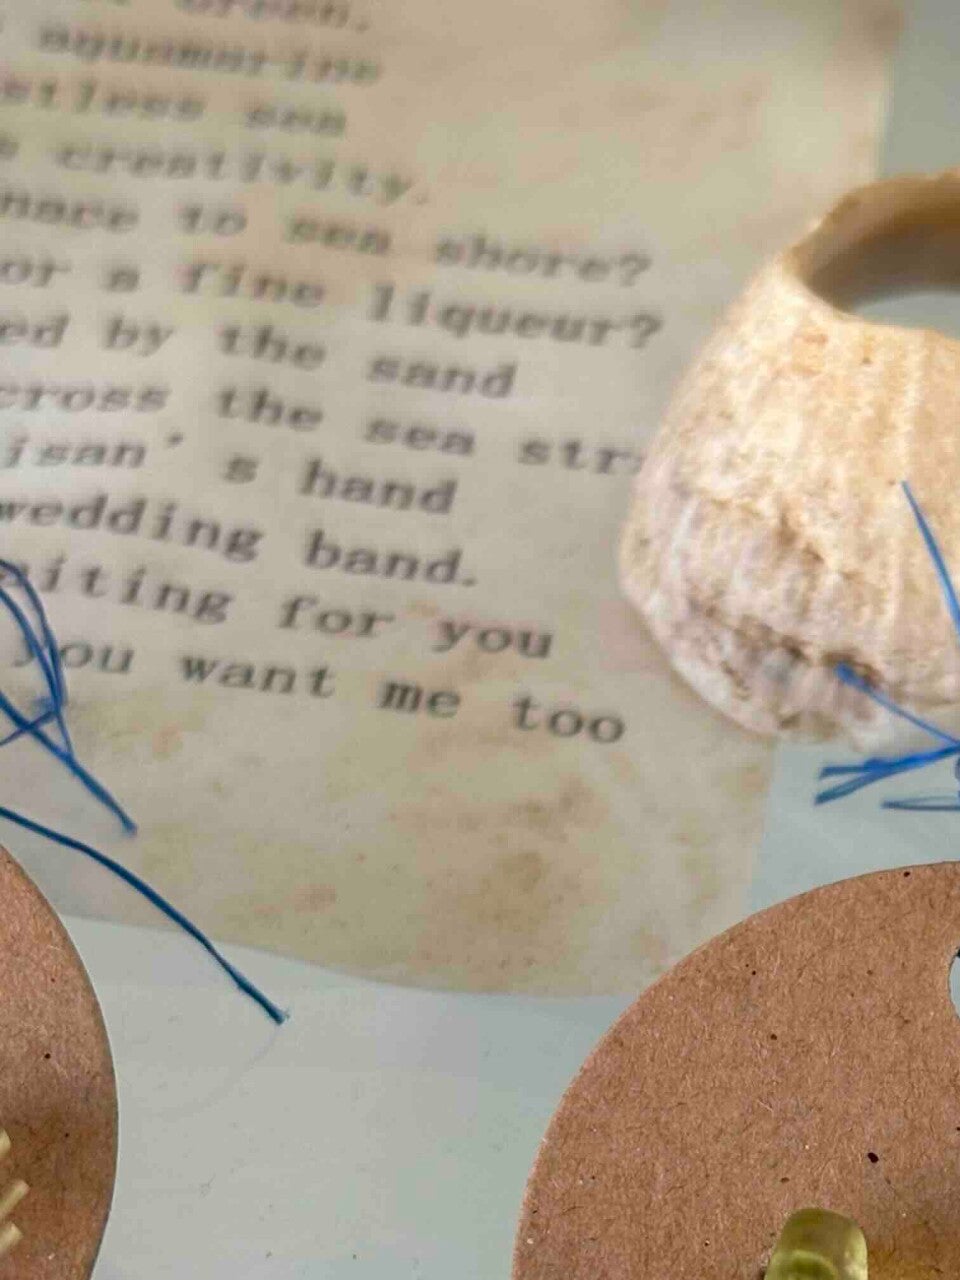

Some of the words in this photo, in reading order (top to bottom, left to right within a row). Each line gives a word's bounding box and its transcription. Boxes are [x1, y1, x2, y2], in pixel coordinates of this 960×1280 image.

[177, 203, 247, 236] to
[436, 230, 652, 286] shore?
[180, 261, 326, 308] fine
[370, 281, 664, 349] liqueur?
[104, 313, 174, 357] by
[218, 323, 328, 371] the
[367, 354, 518, 400] sand
[216, 386, 324, 432] the
[365, 416, 476, 457] sea
[298, 455, 458, 516] hand
[303, 526, 478, 588] band.
[277, 593, 397, 638] for
[431, 618, 554, 660] you
[180, 654, 337, 699] want
[377, 679, 461, 720] me
[511, 694, 626, 745] too
